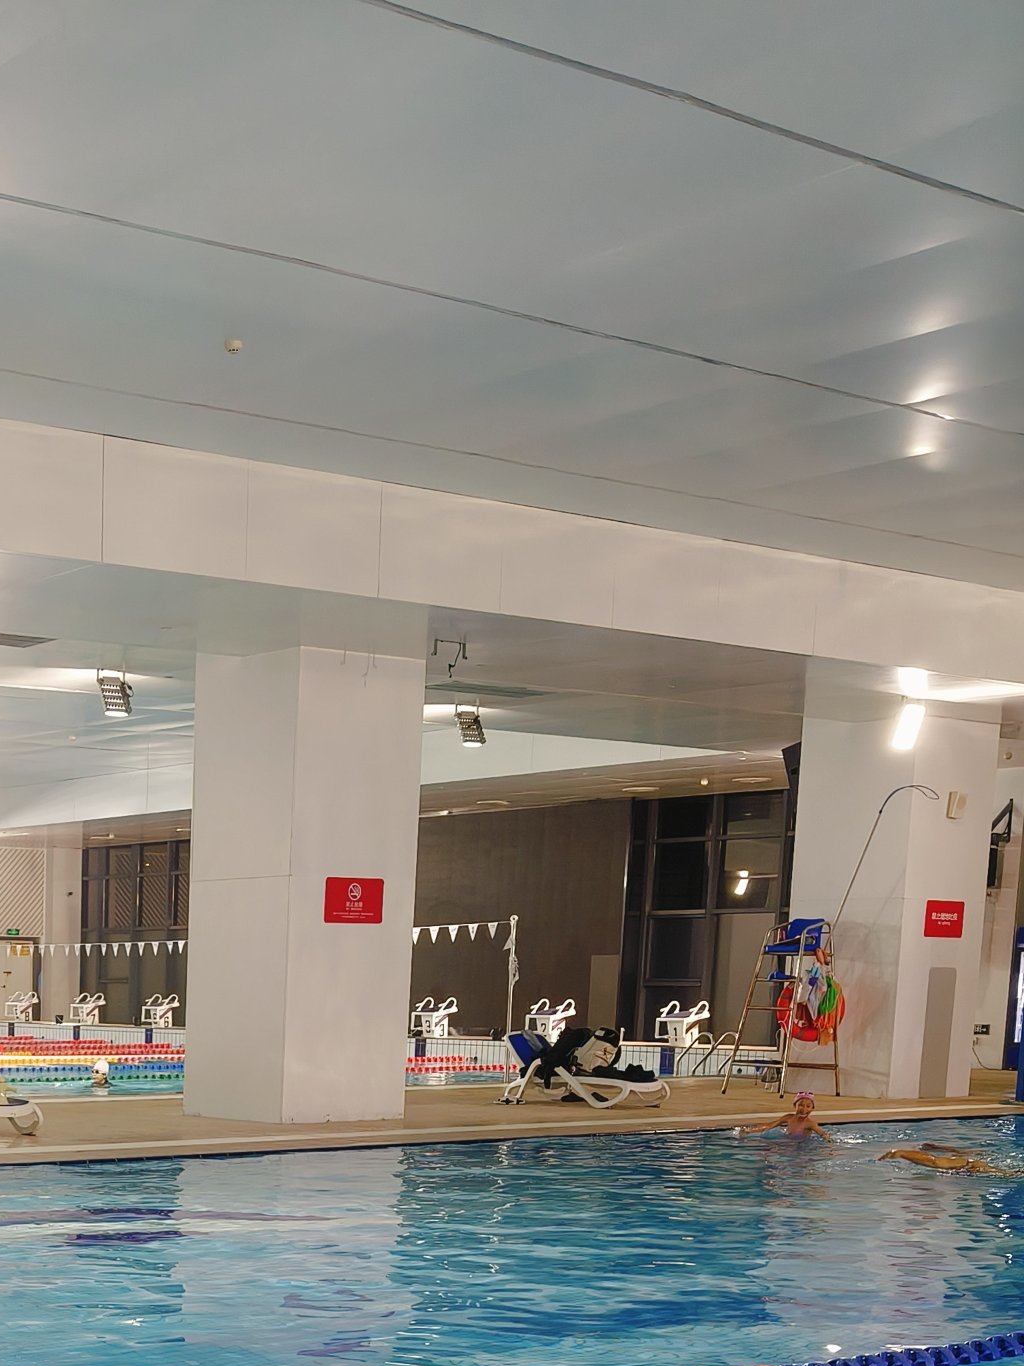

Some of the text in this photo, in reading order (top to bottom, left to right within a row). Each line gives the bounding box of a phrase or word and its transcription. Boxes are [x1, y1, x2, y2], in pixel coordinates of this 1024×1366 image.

[91, 1013, 96, 1025] 7
[164, 1016, 169, 1028] 6
[425, 1020, 430, 1034] 3
[439, 1023, 445, 1037] 3
